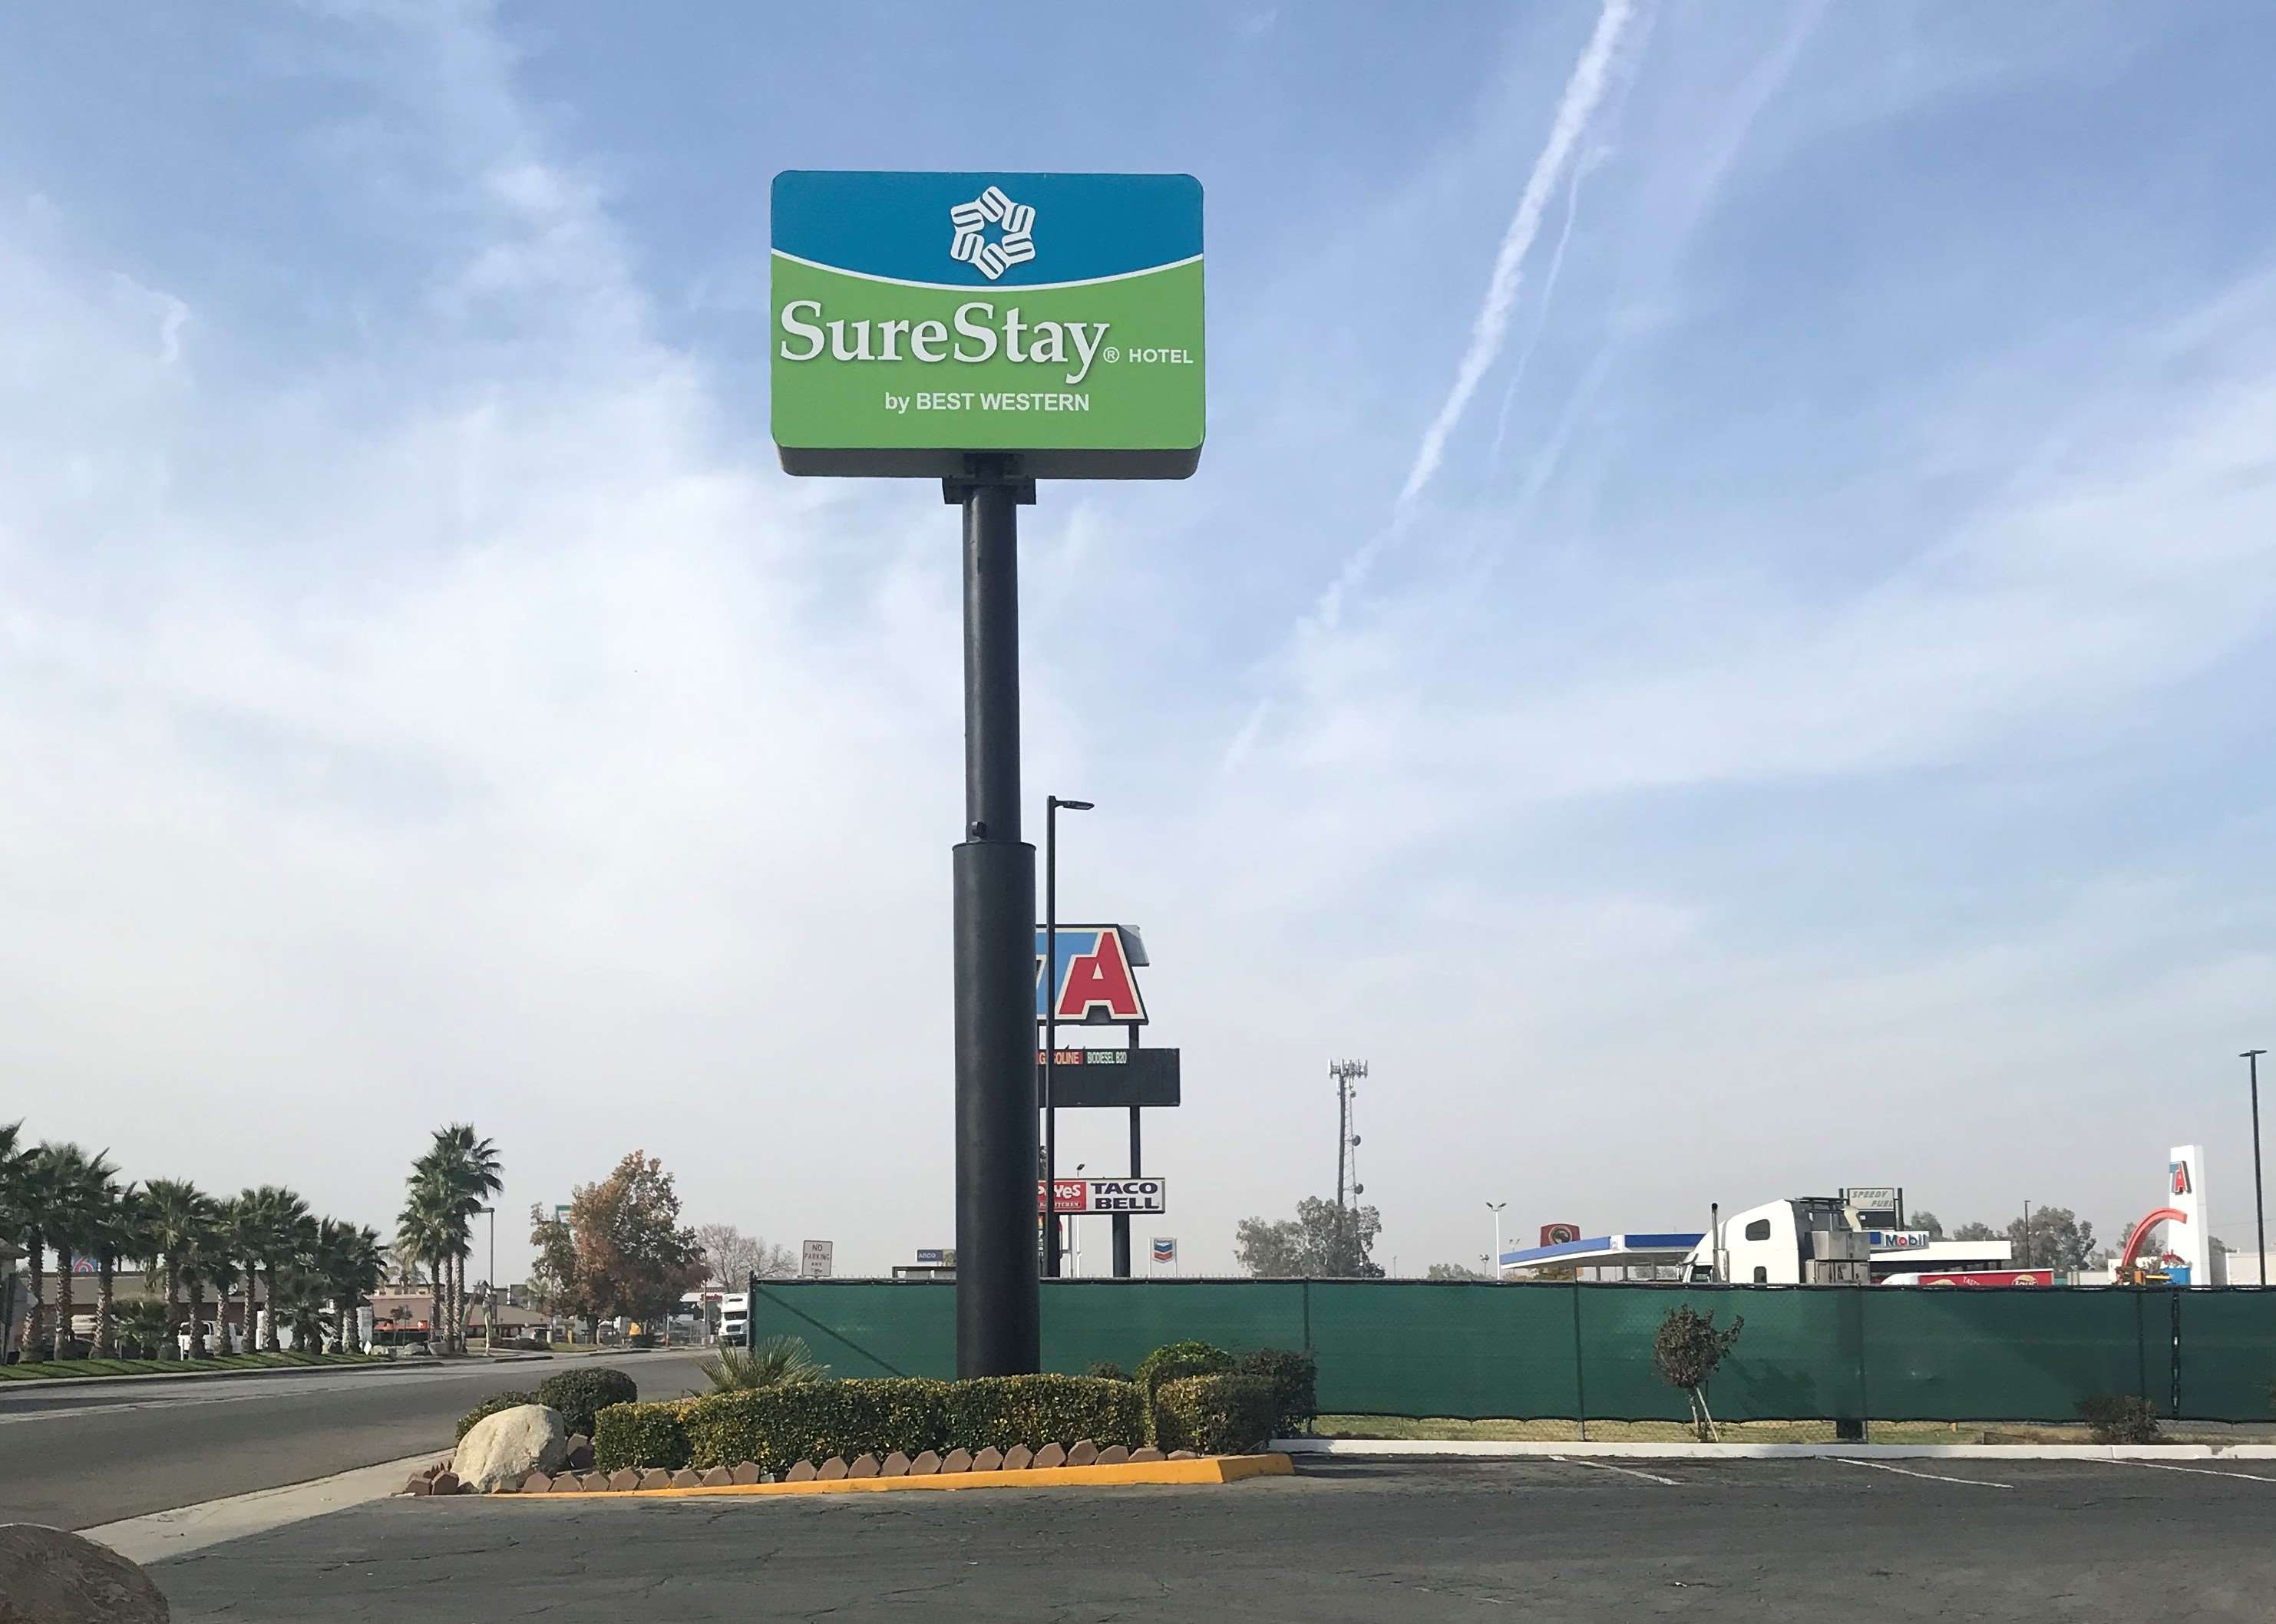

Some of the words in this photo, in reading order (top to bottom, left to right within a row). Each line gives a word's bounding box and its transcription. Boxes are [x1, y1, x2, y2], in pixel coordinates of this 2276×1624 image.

[1129, 348, 1194, 365] HOTEL
[884, 392, 910, 414] by
[916, 393, 975, 411] BEST
[979, 393, 1090, 411] WESTERN
[1039, 1051, 1080, 1065] GOLINE
[1091, 1183, 1158, 1194] TACO
[1852, 1190, 1888, 1199] SPEEDY
[1095, 1197, 1160, 1210] BELL
[1885, 1234, 1926, 1247] Mobil
